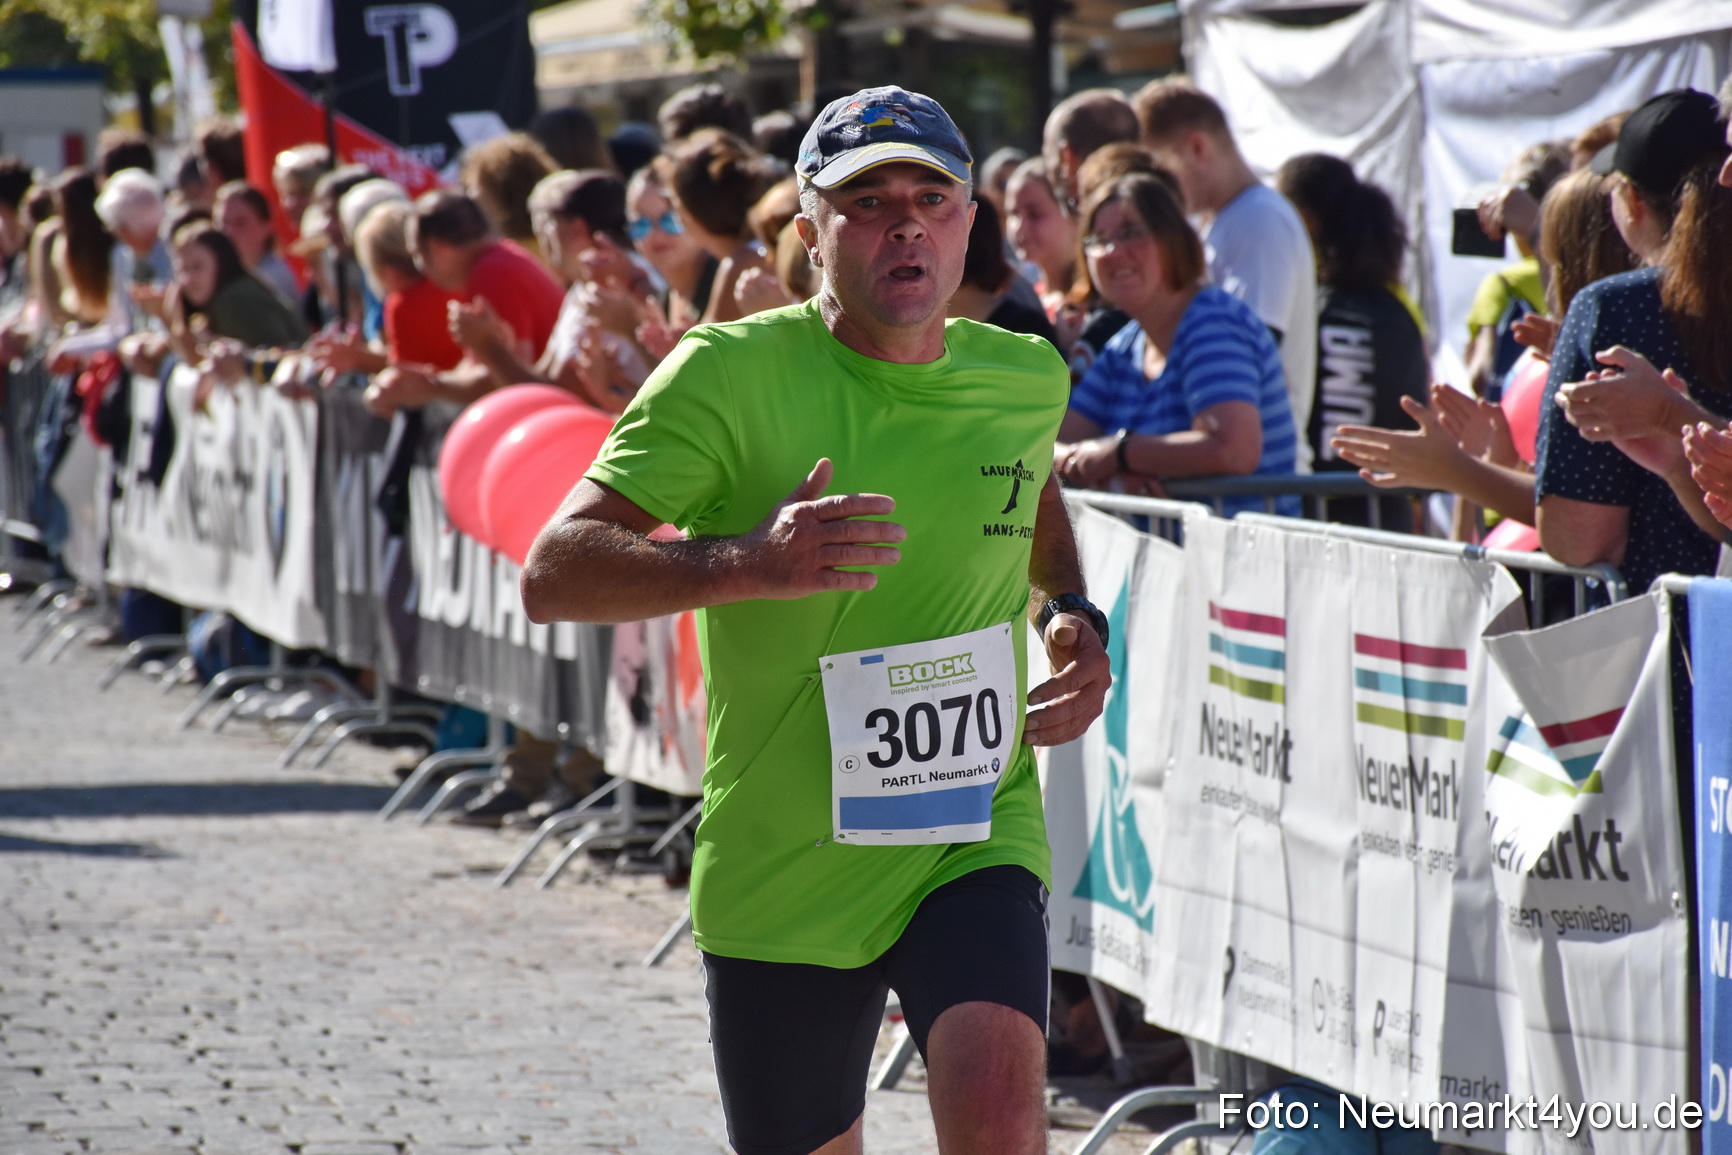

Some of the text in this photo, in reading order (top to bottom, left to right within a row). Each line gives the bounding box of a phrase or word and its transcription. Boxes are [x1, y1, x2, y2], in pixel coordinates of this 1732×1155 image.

[887, 651, 976, 688] BOCK
[890, 674, 978, 696] inspired by smart concepts
[865, 687, 1003, 769] 3070
[845, 759, 853, 770] C
[881, 763, 989, 788] PARTL Neumarkt
[1354, 742, 1460, 823] NeuerMark
[1710, 917, 1732, 979] N
[1709, 1062, 1732, 1125] D
